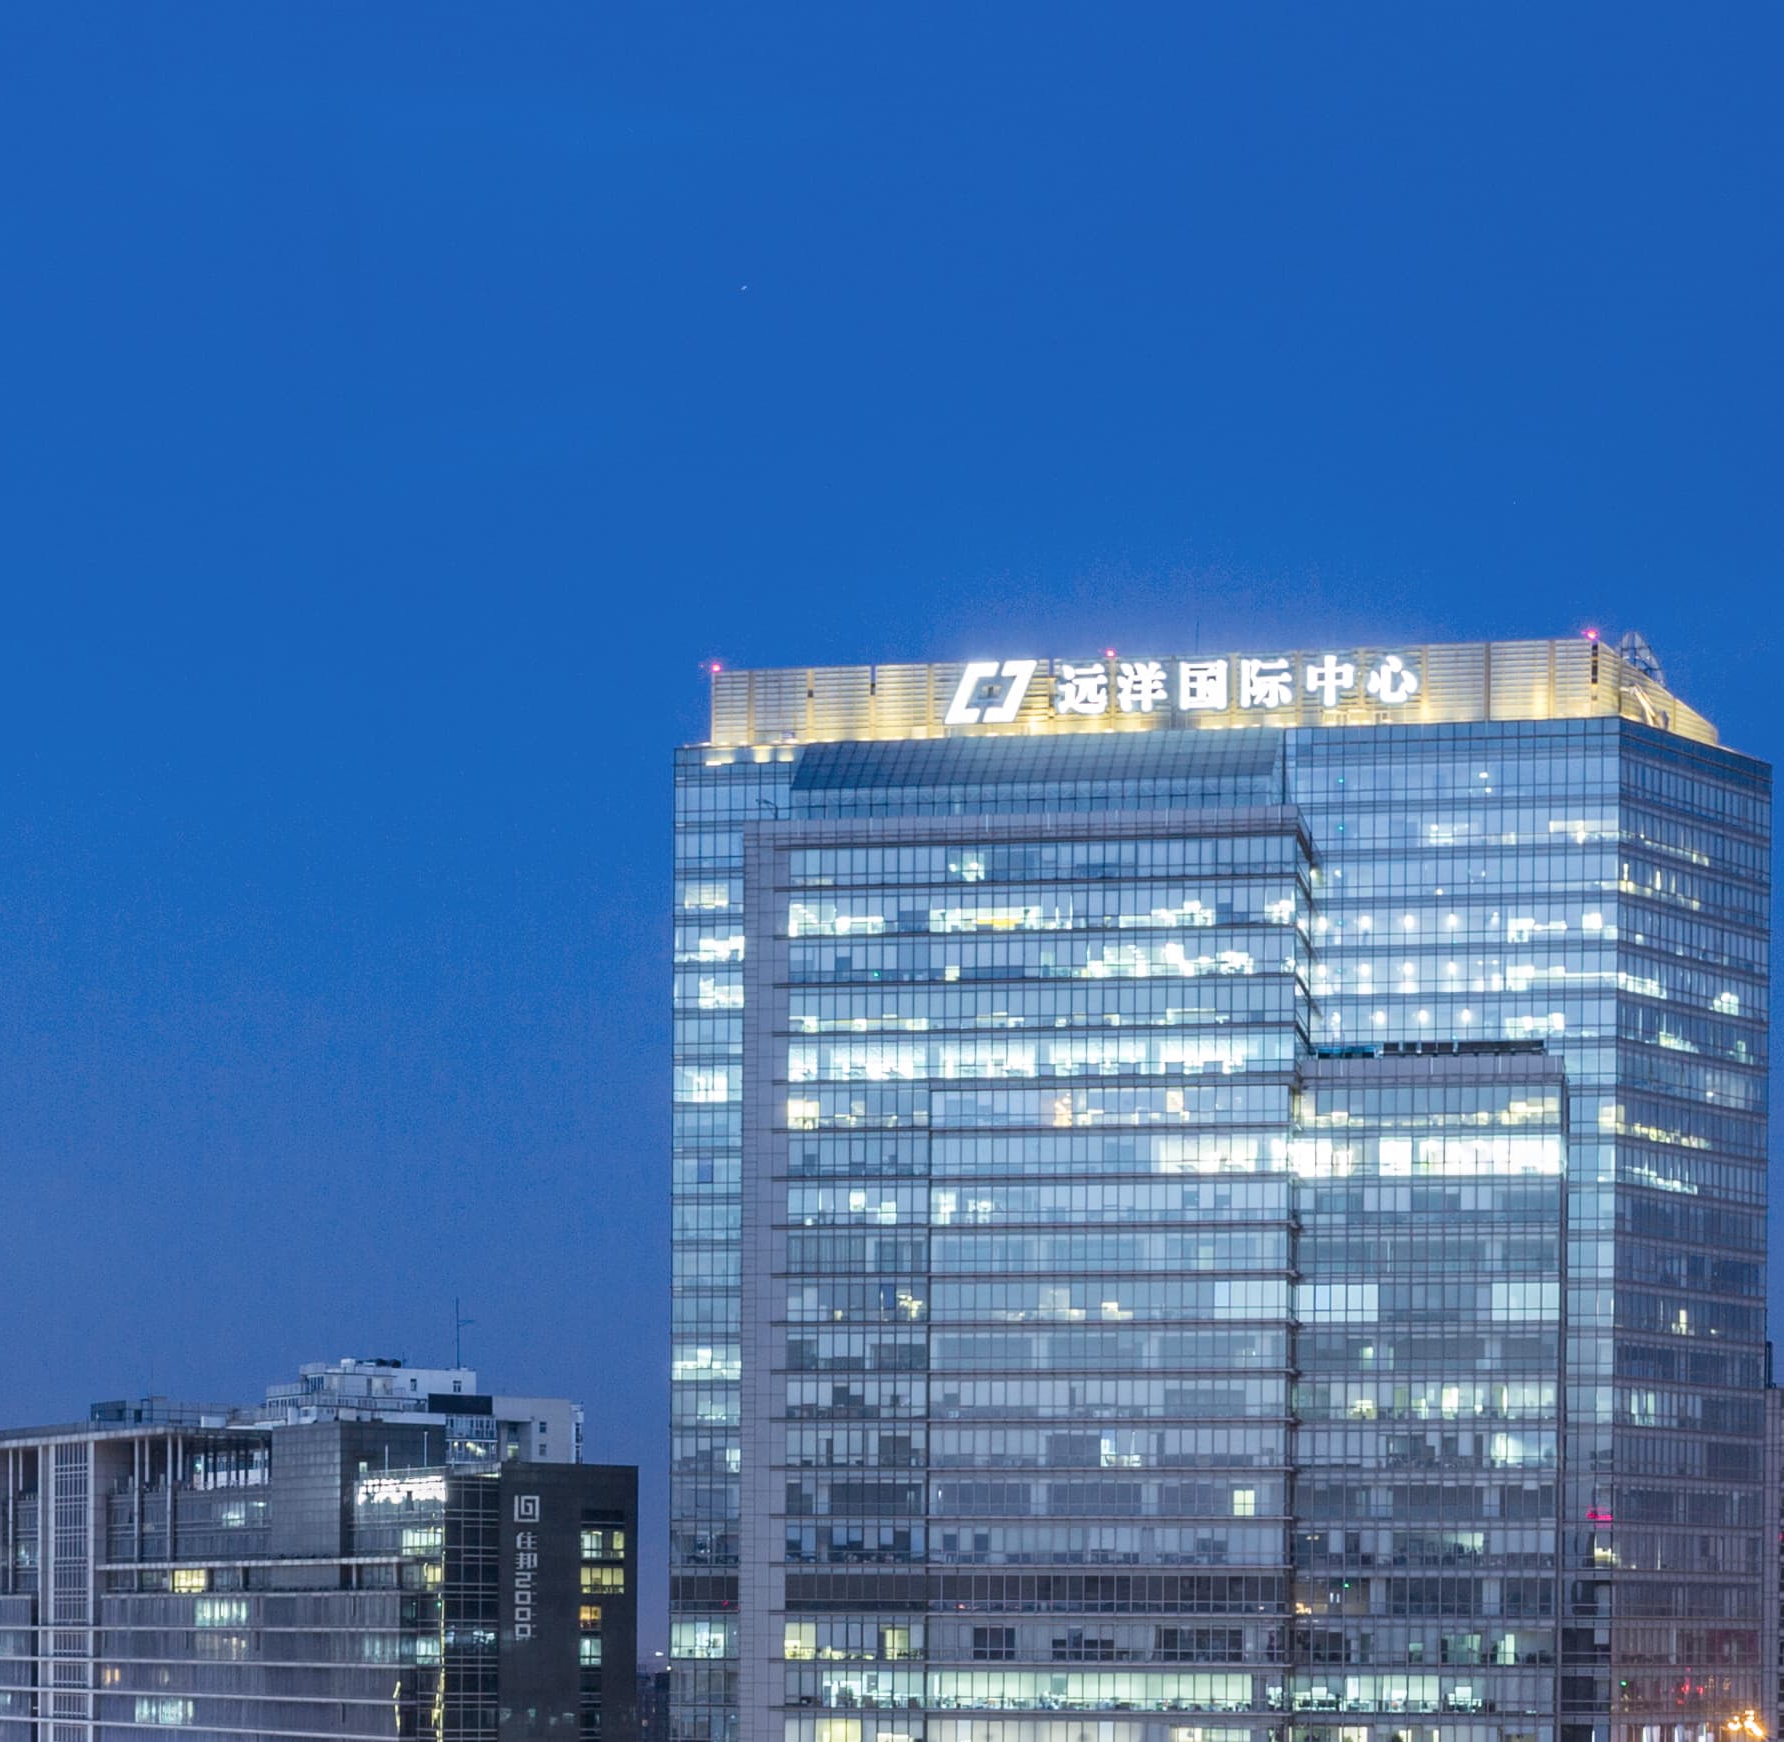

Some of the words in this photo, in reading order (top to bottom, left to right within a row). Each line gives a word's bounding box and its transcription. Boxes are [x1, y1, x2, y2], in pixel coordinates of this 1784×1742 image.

[1056, 654, 1419, 714] 远洋国际中心
[515, 1532, 537, 1637] 住邦2000
